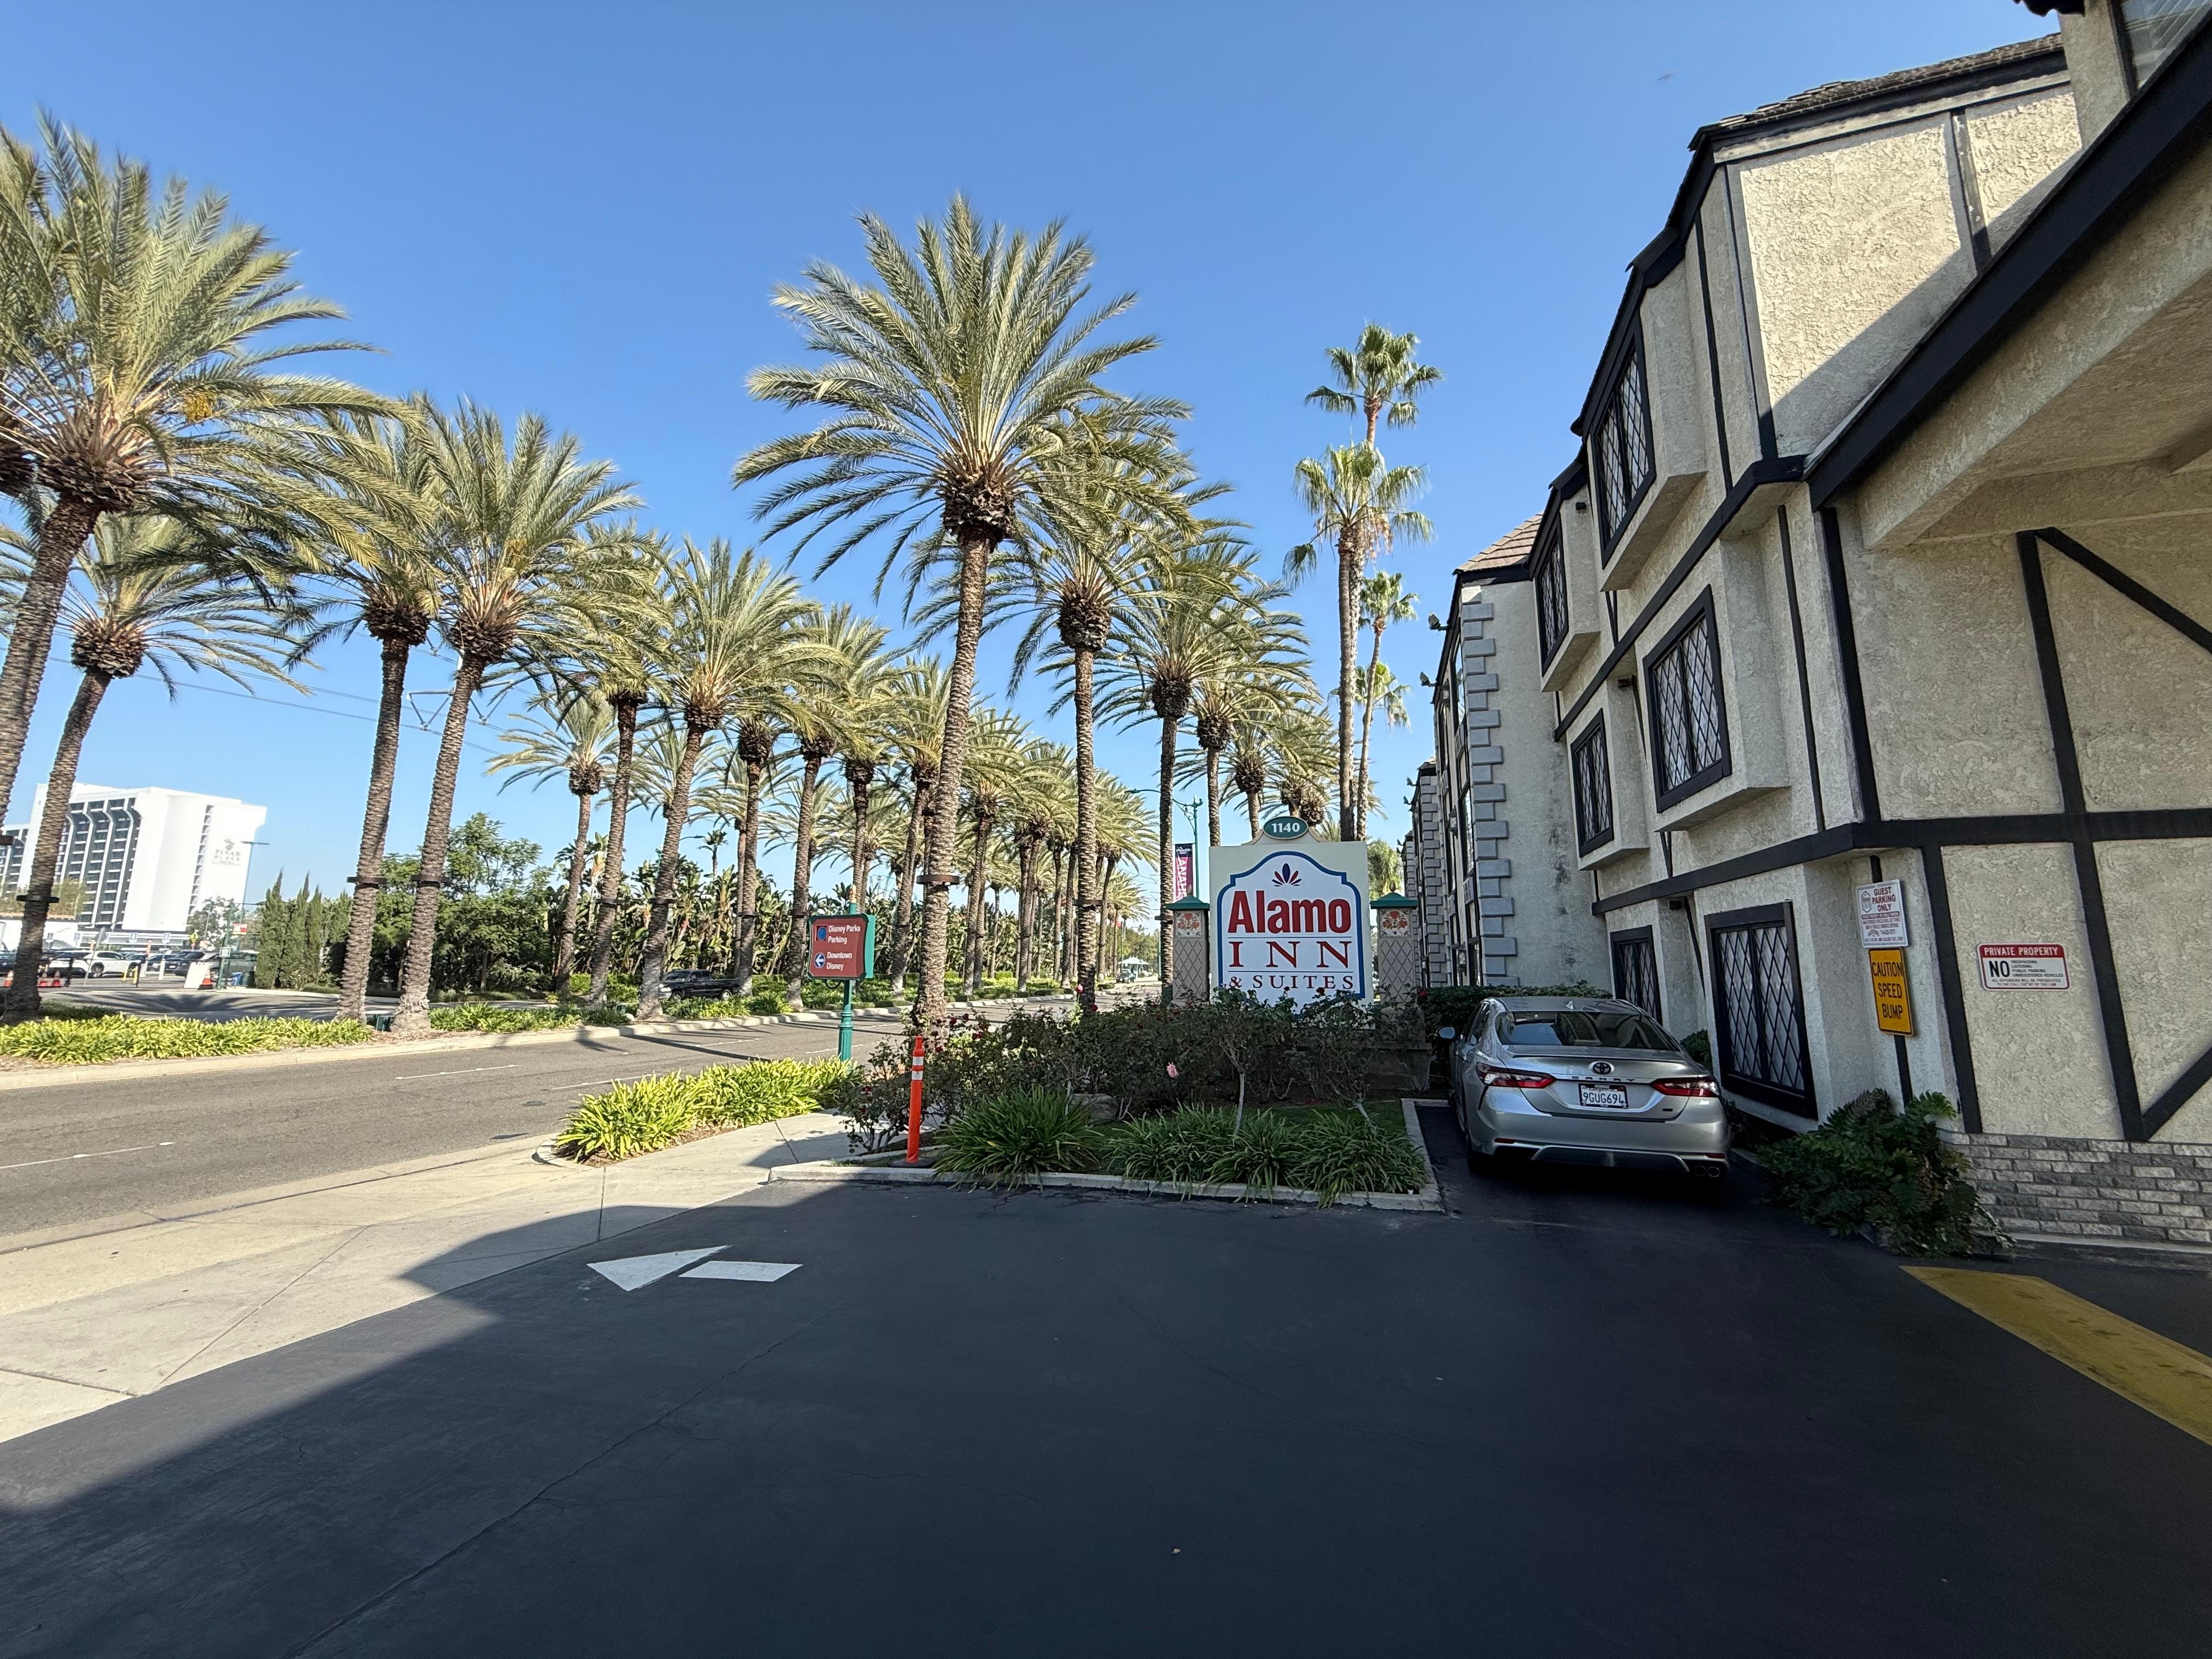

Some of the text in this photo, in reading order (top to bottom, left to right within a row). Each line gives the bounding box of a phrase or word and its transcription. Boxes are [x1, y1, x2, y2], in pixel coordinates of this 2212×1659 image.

[1271, 822, 1300, 833] 1140
[1874, 887, 1892, 896] GUEST
[1871, 894, 1896, 905] PARKING
[1228, 890, 1351, 934] Alamo
[1877, 904, 1892, 912] ONLY
[828, 925, 845, 933] Disney
[828, 936, 848, 944] Parking
[1229, 941, 1352, 968] INN
[1984, 947, 2058, 956] PRIVATE PROPERTY
[826, 962, 844, 971] Disney
[1872, 962, 1903, 977] CAUTION
[1989, 961, 2010, 977] NO
[1229, 975, 1353, 989] & SUITES
[1878, 983, 1902, 998] SPEED
[1882, 1003, 1903, 1019] BUMP
[1583, 1092, 1624, 1104] 9GUG694
